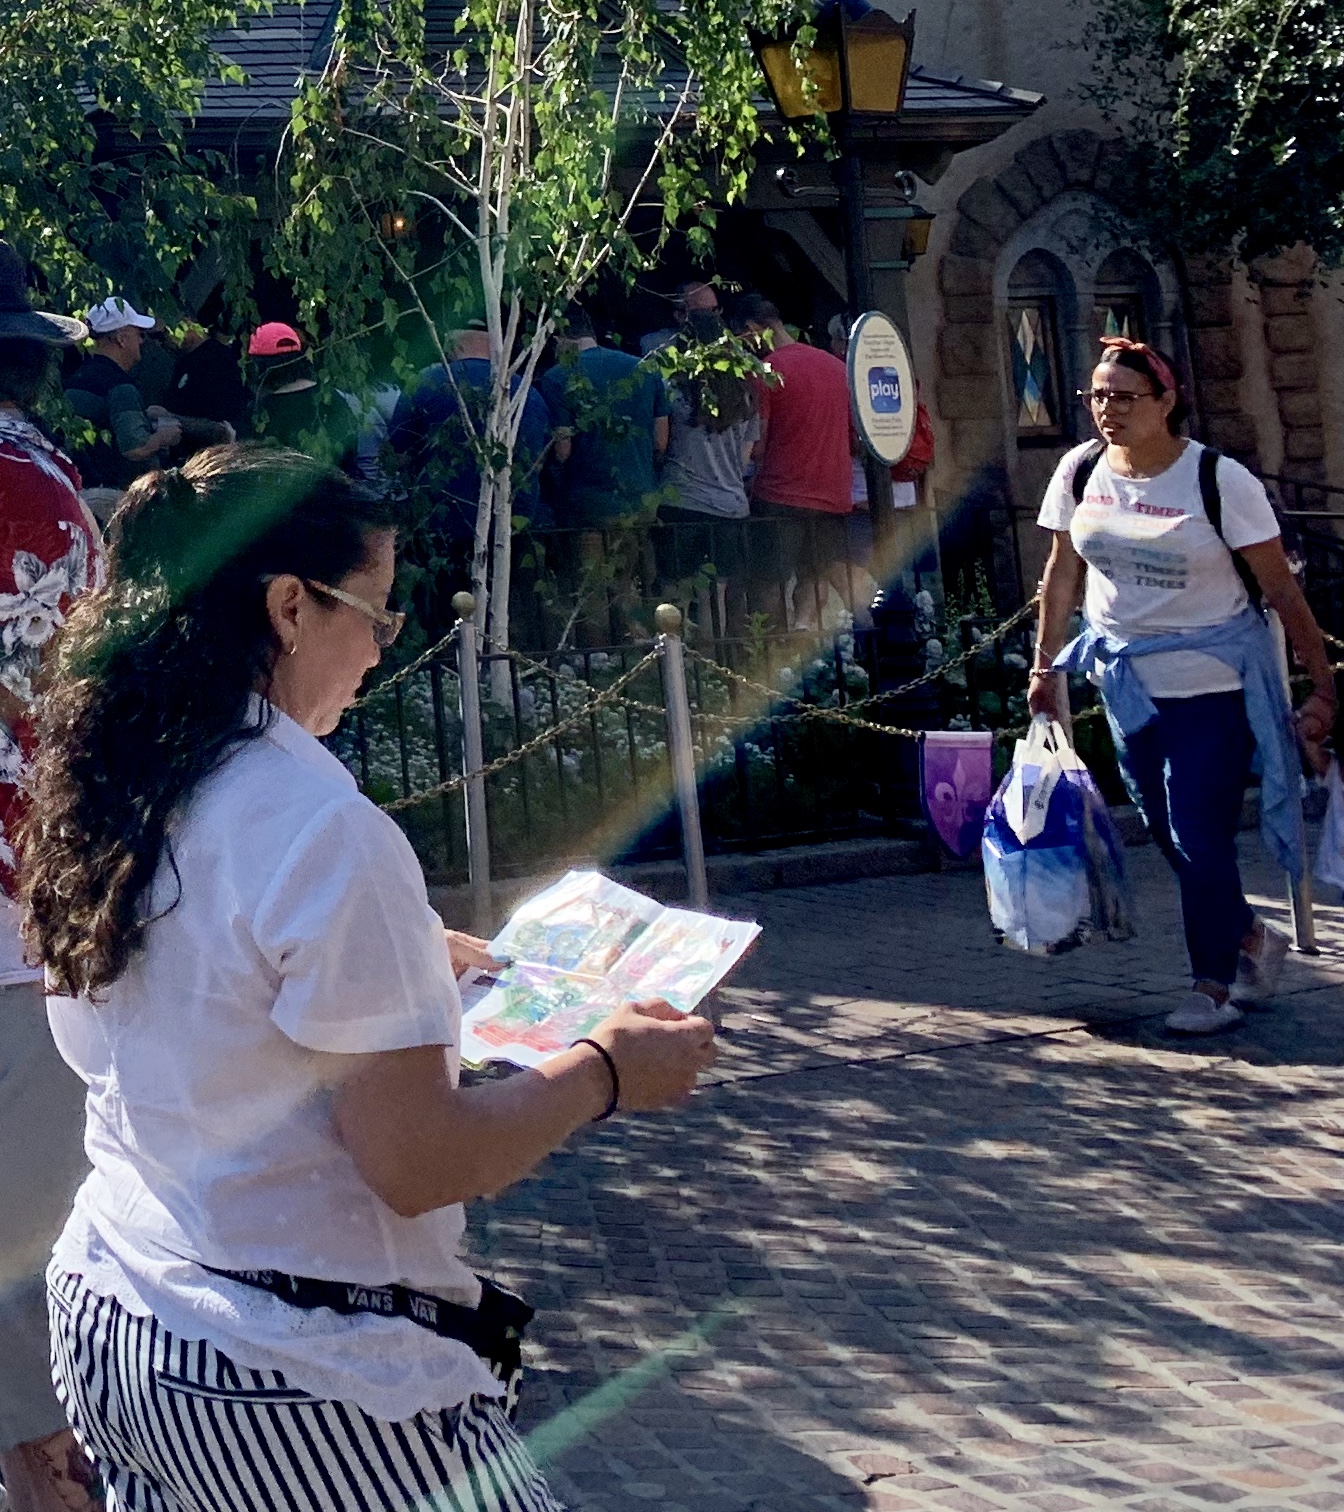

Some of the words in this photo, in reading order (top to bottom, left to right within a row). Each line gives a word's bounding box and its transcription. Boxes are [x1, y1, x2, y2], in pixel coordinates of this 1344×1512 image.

[870, 380, 900, 401] play
[1135, 502, 1186, 518] TIMES
[1134, 575, 1187, 590] TIMES
[346, 1284, 395, 1313] VANS
